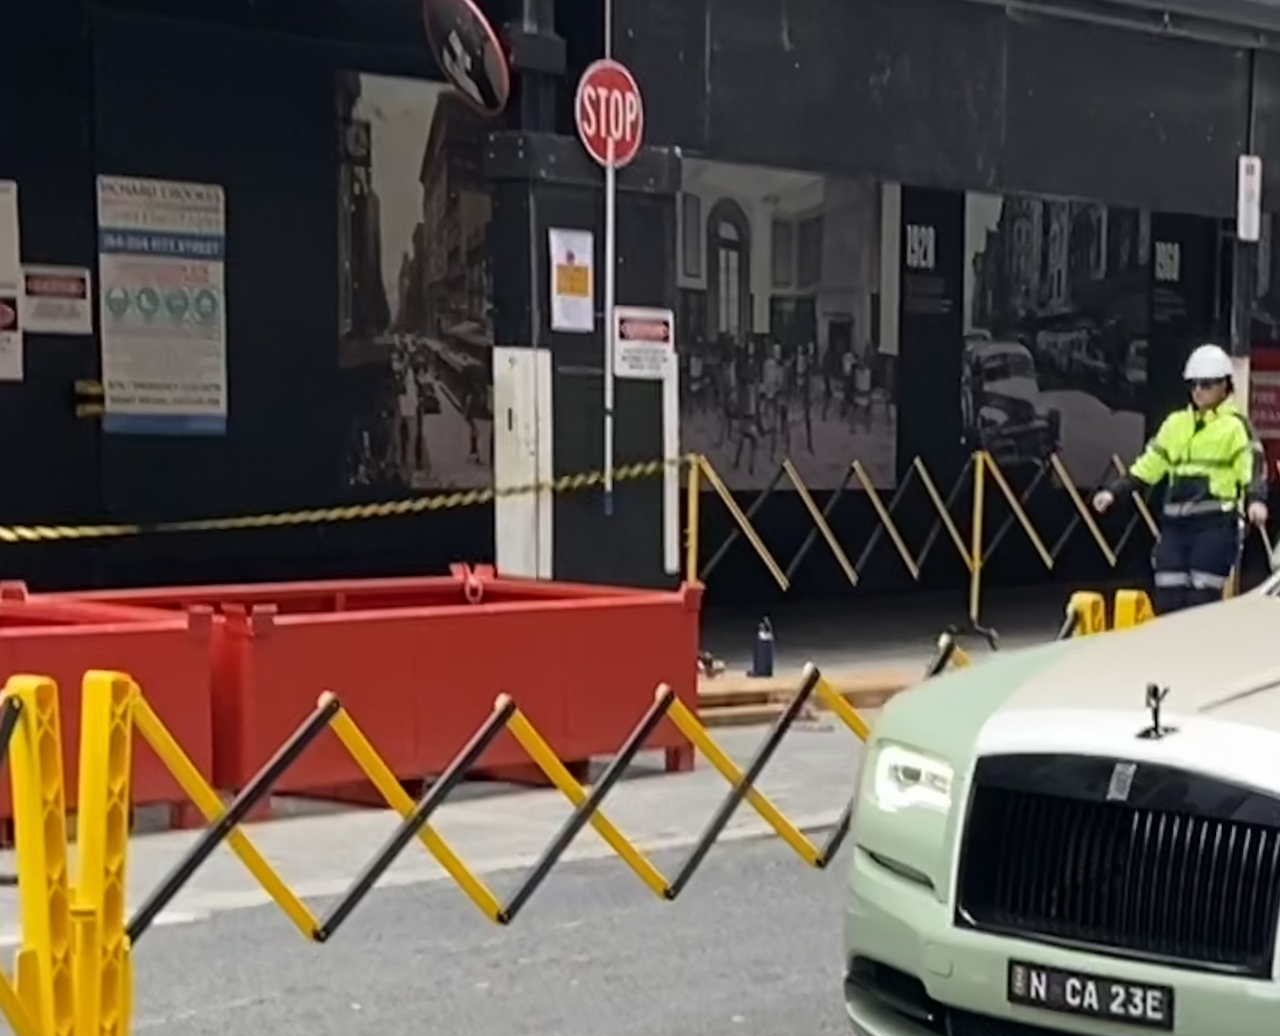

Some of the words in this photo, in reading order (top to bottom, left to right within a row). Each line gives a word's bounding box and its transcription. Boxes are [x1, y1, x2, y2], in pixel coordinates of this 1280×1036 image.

[583, 85, 638, 141] STOP
[907, 224, 936, 268] 1920
[1109, 985, 1163, 1020] 23E
